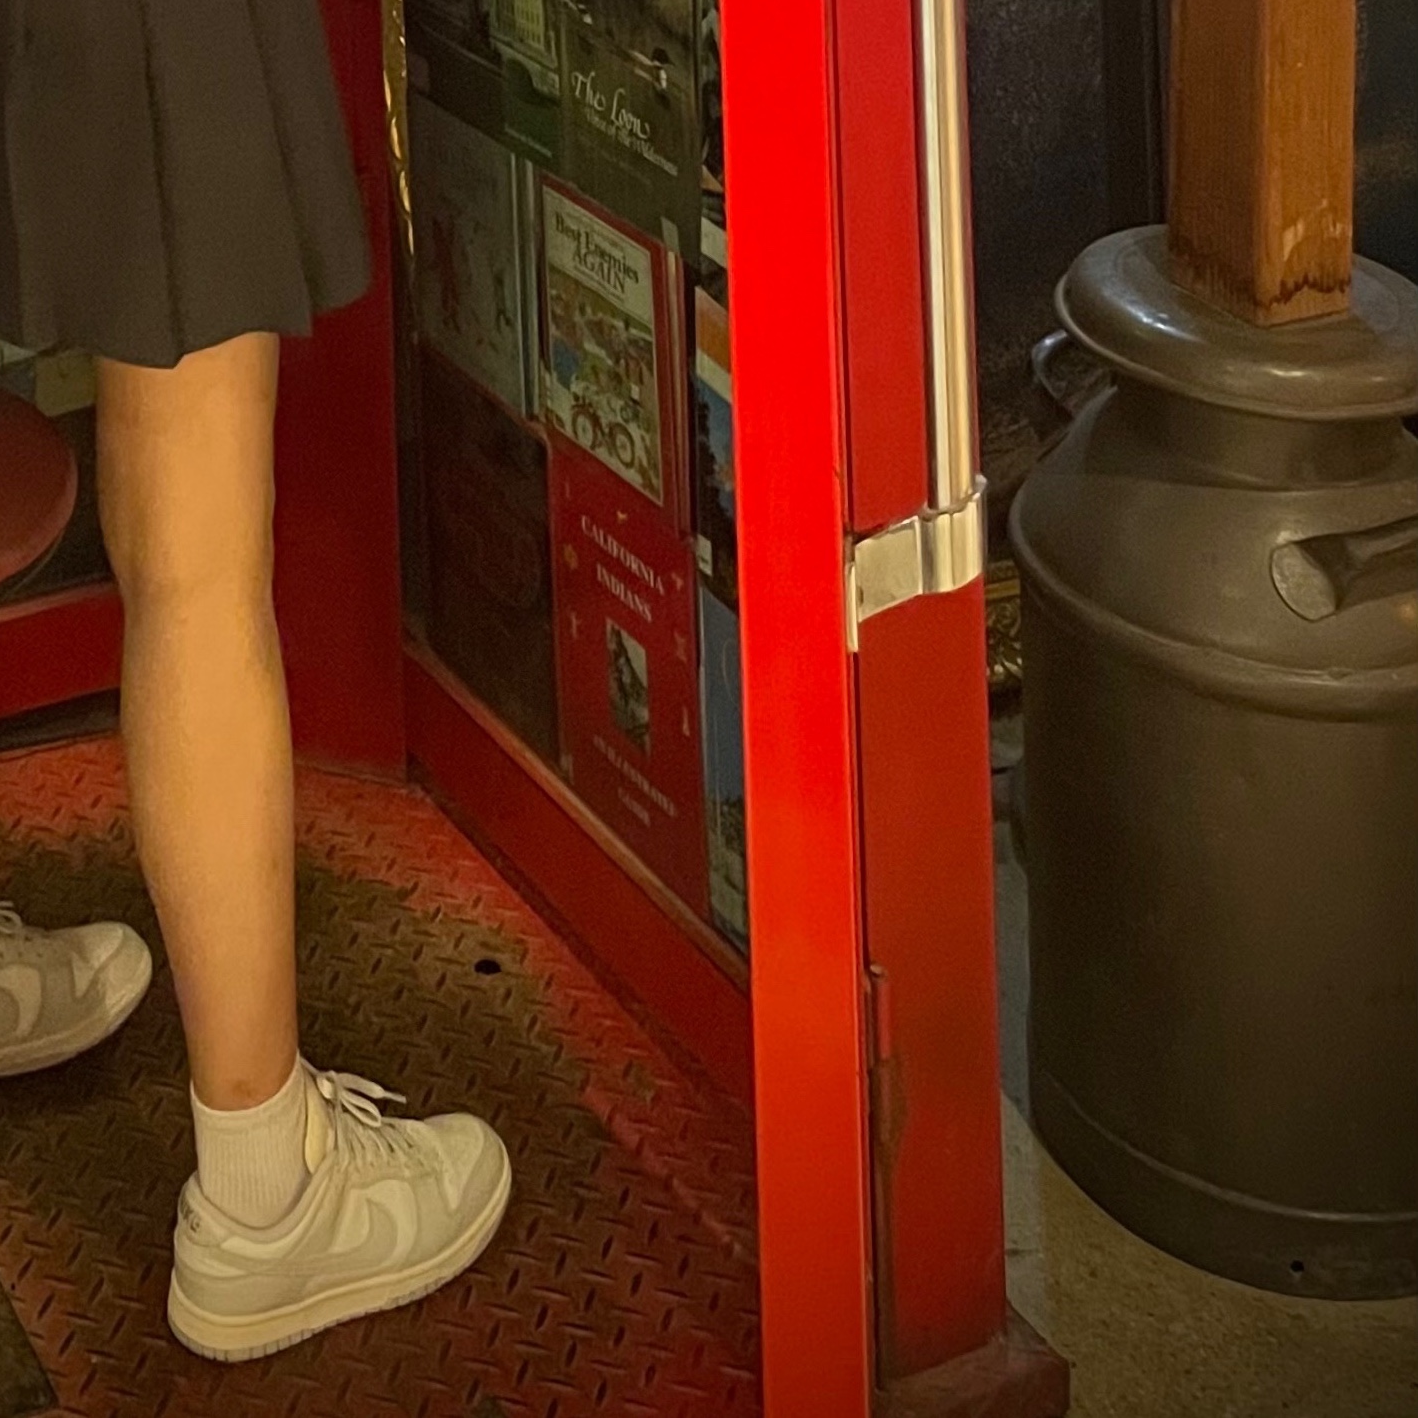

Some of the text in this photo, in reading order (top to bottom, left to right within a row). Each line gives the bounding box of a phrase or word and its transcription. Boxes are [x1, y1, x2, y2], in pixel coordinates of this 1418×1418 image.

[571, 71, 606, 111] The
[555, 211, 581, 245] Best
[584, 231, 640, 284] Enemies
[573, 245, 626, 294] AGAIN
[581, 515, 665, 596] CALIFORNIA
[597, 563, 652, 623] INDIANS
